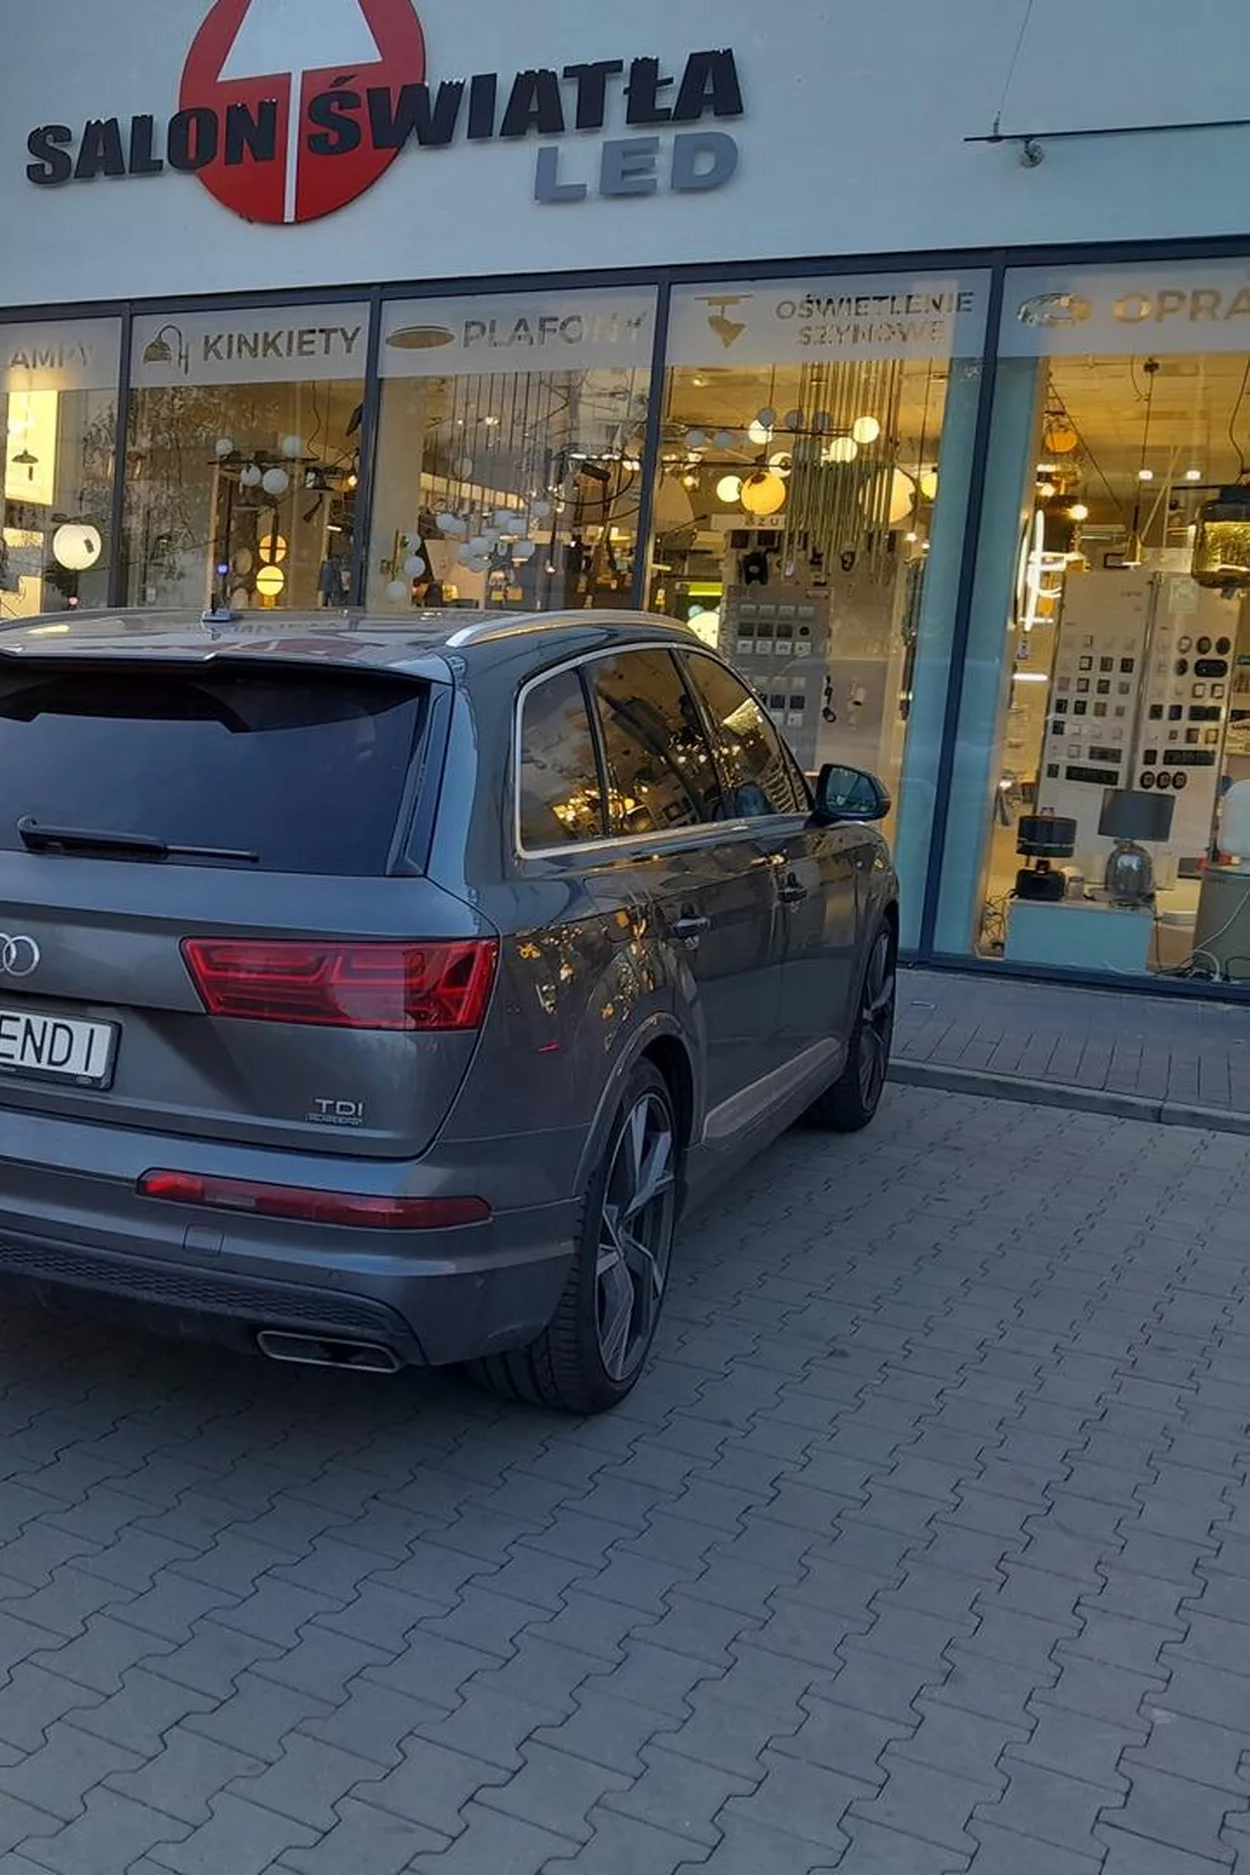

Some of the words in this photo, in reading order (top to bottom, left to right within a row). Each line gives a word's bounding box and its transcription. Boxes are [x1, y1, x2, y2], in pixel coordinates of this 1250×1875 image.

[27, 99, 277, 185] SALON
[306, 48, 744, 157] ŚWIATŁA
[535, 132, 739, 203] LED
[776, 292, 974, 320] OŚWIETLENIE
[203, 325, 362, 361] KINKIETY
[315, 1098, 363, 1117] TDI
